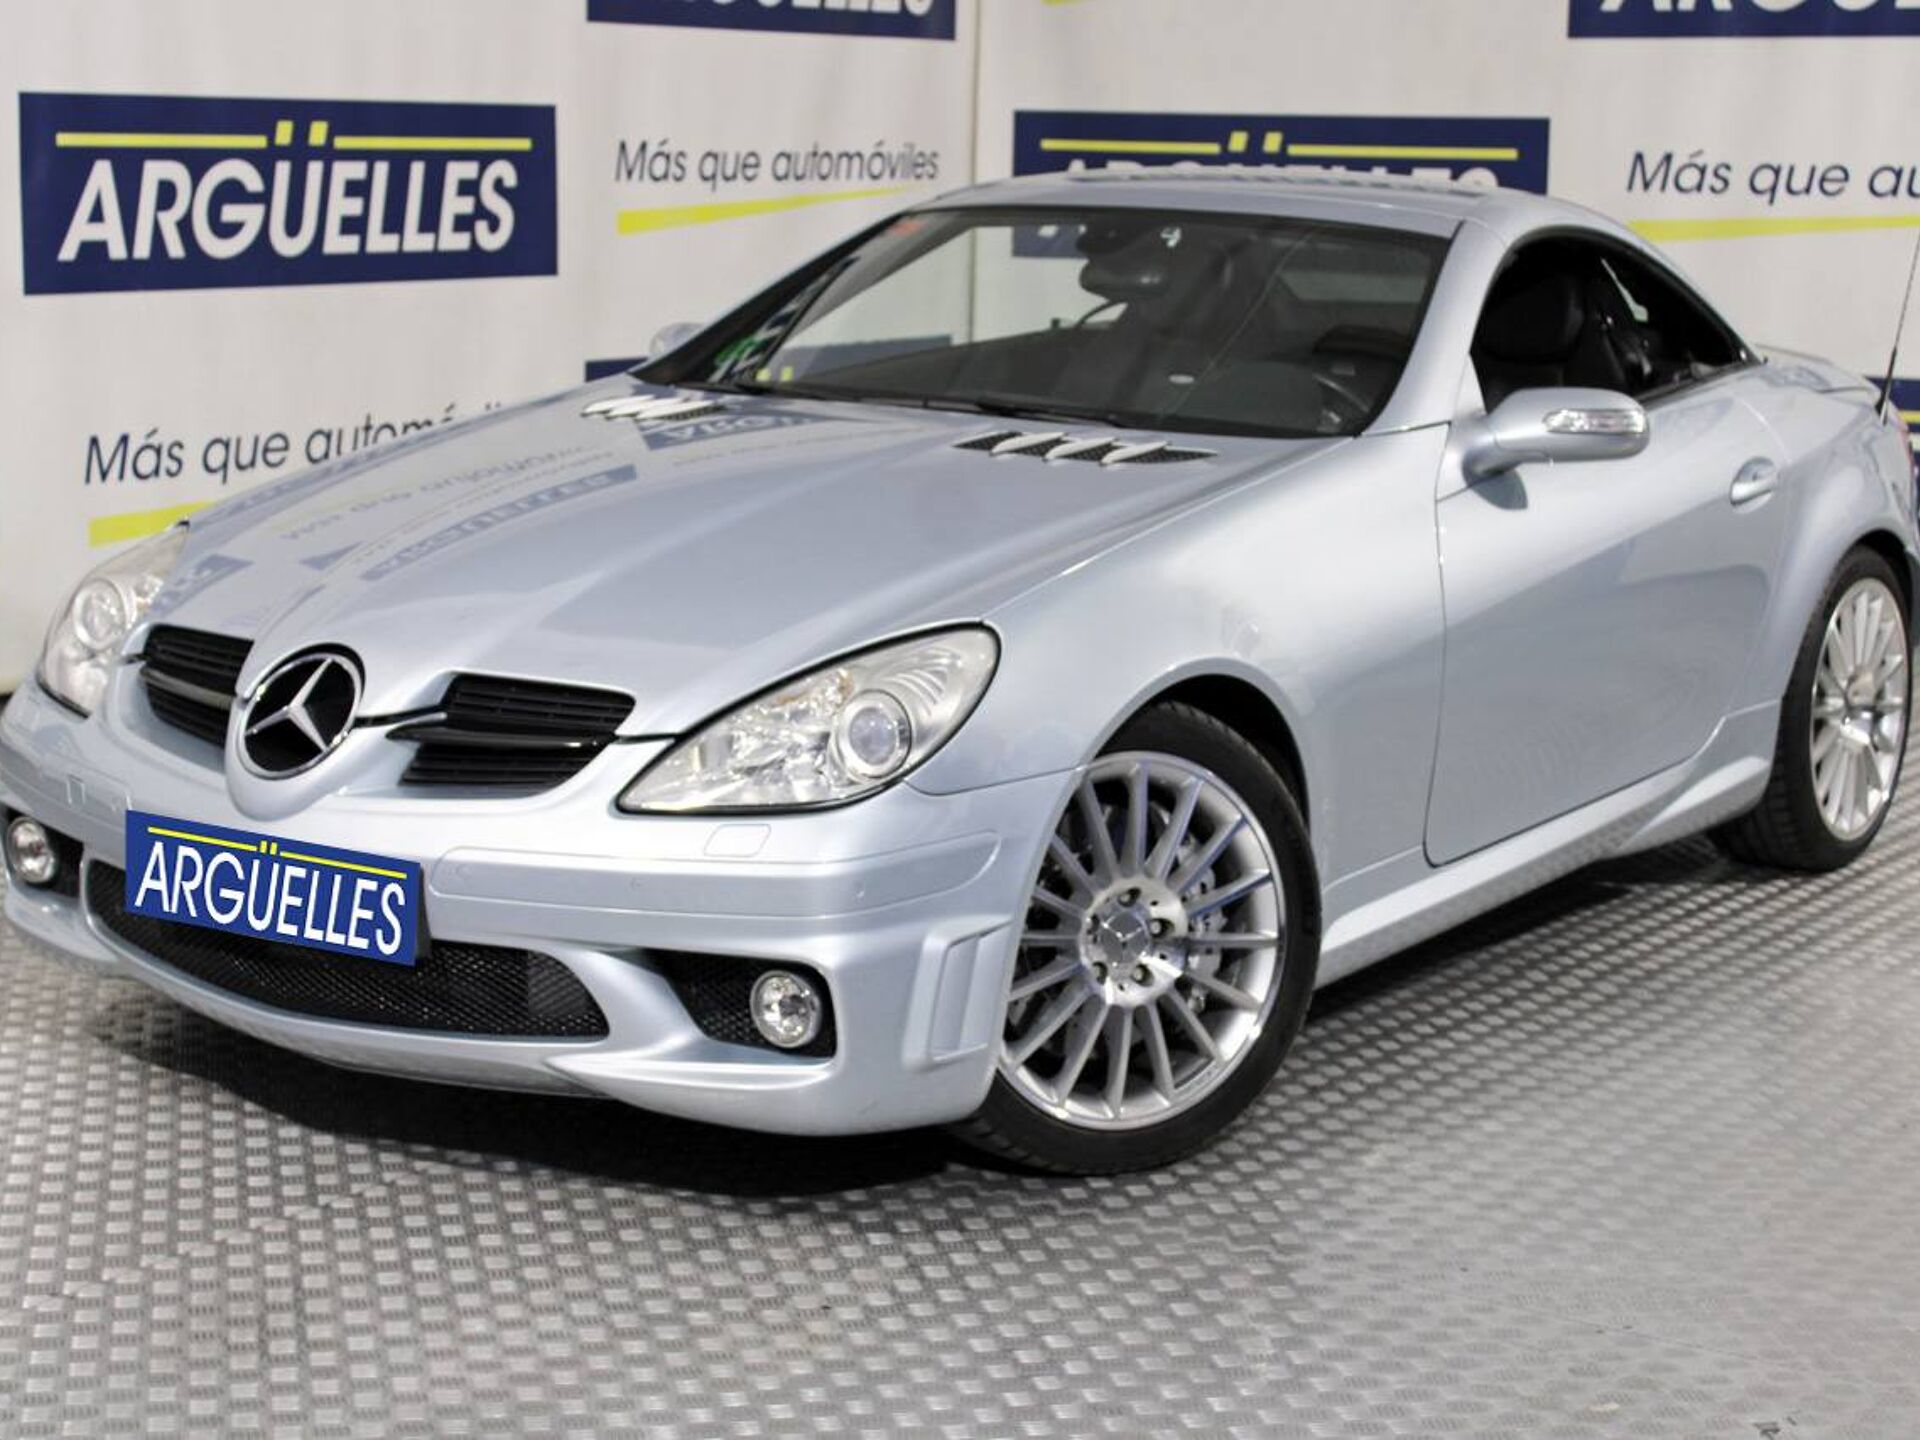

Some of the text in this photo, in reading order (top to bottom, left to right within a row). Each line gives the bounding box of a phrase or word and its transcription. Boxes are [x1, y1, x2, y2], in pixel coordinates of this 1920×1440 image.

[57, 120, 518, 262] ARGÜELLES
[614, 138, 940, 192] Más que automóviles
[1626, 149, 1732, 194] Más
[1749, 162, 1850, 206] que
[84, 427, 185, 485] Más
[201, 431, 290, 485] que
[134, 840, 406, 955] ARGÜELLES
